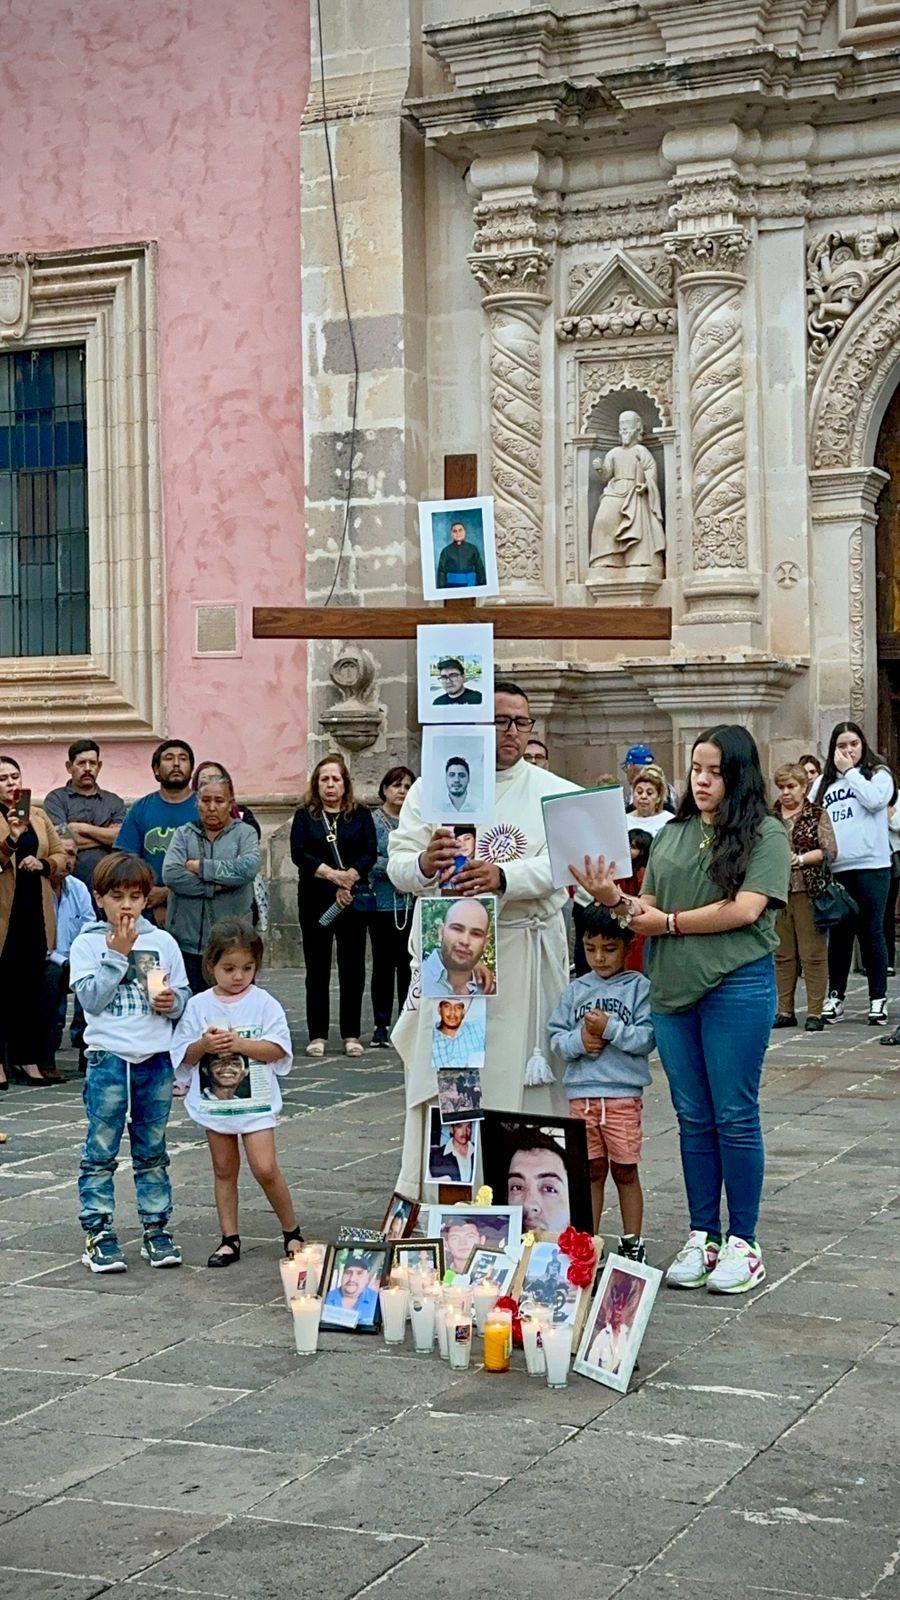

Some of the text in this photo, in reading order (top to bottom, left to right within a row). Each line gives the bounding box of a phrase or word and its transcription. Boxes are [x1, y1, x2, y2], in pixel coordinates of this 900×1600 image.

[832, 807, 853, 822] USA
[575, 998, 631, 1025] LOS ANGELES
